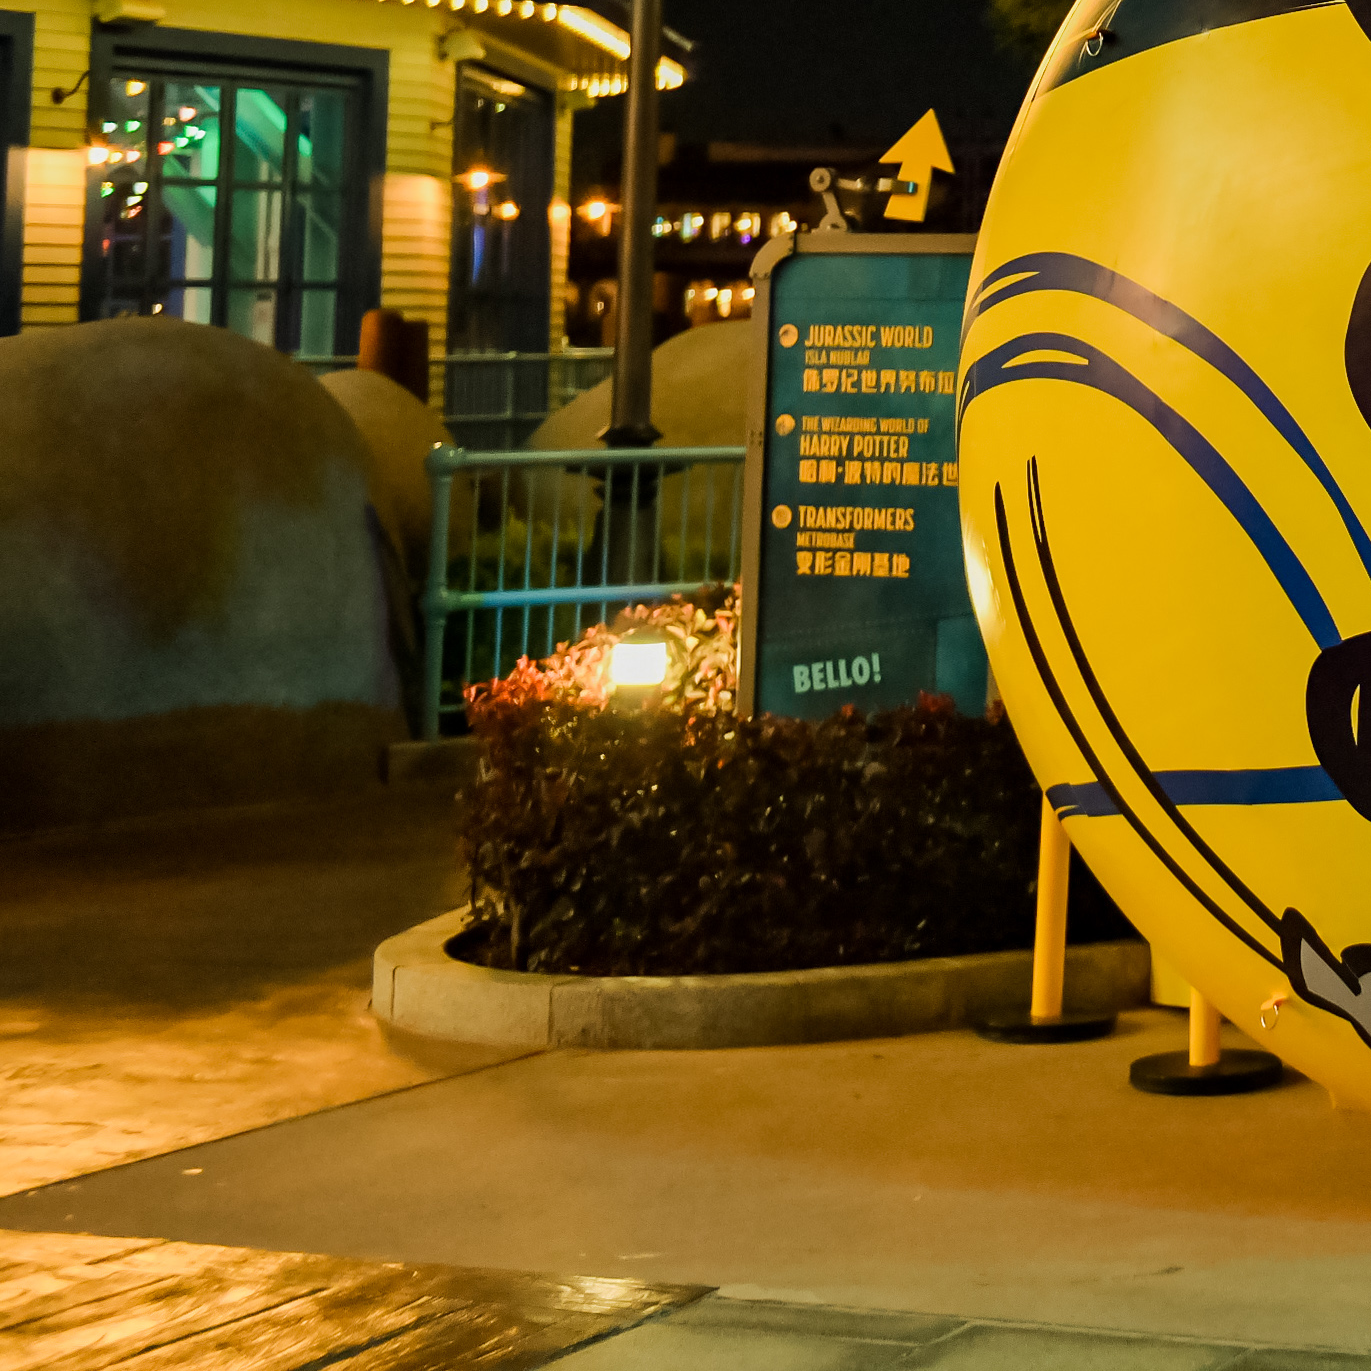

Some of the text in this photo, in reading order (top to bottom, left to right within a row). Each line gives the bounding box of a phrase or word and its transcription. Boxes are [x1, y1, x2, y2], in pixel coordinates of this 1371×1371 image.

[805, 324, 934, 349] JURASSIC WORLD
[802, 416, 820, 432] THE
[879, 418, 915, 434] WORLD
[917, 418, 930, 434] OF
[800, 434, 909, 459] HARRY POTTER
[798, 505, 915, 532] TRANSFORMERS
[793, 652, 881, 694] BELLO!
